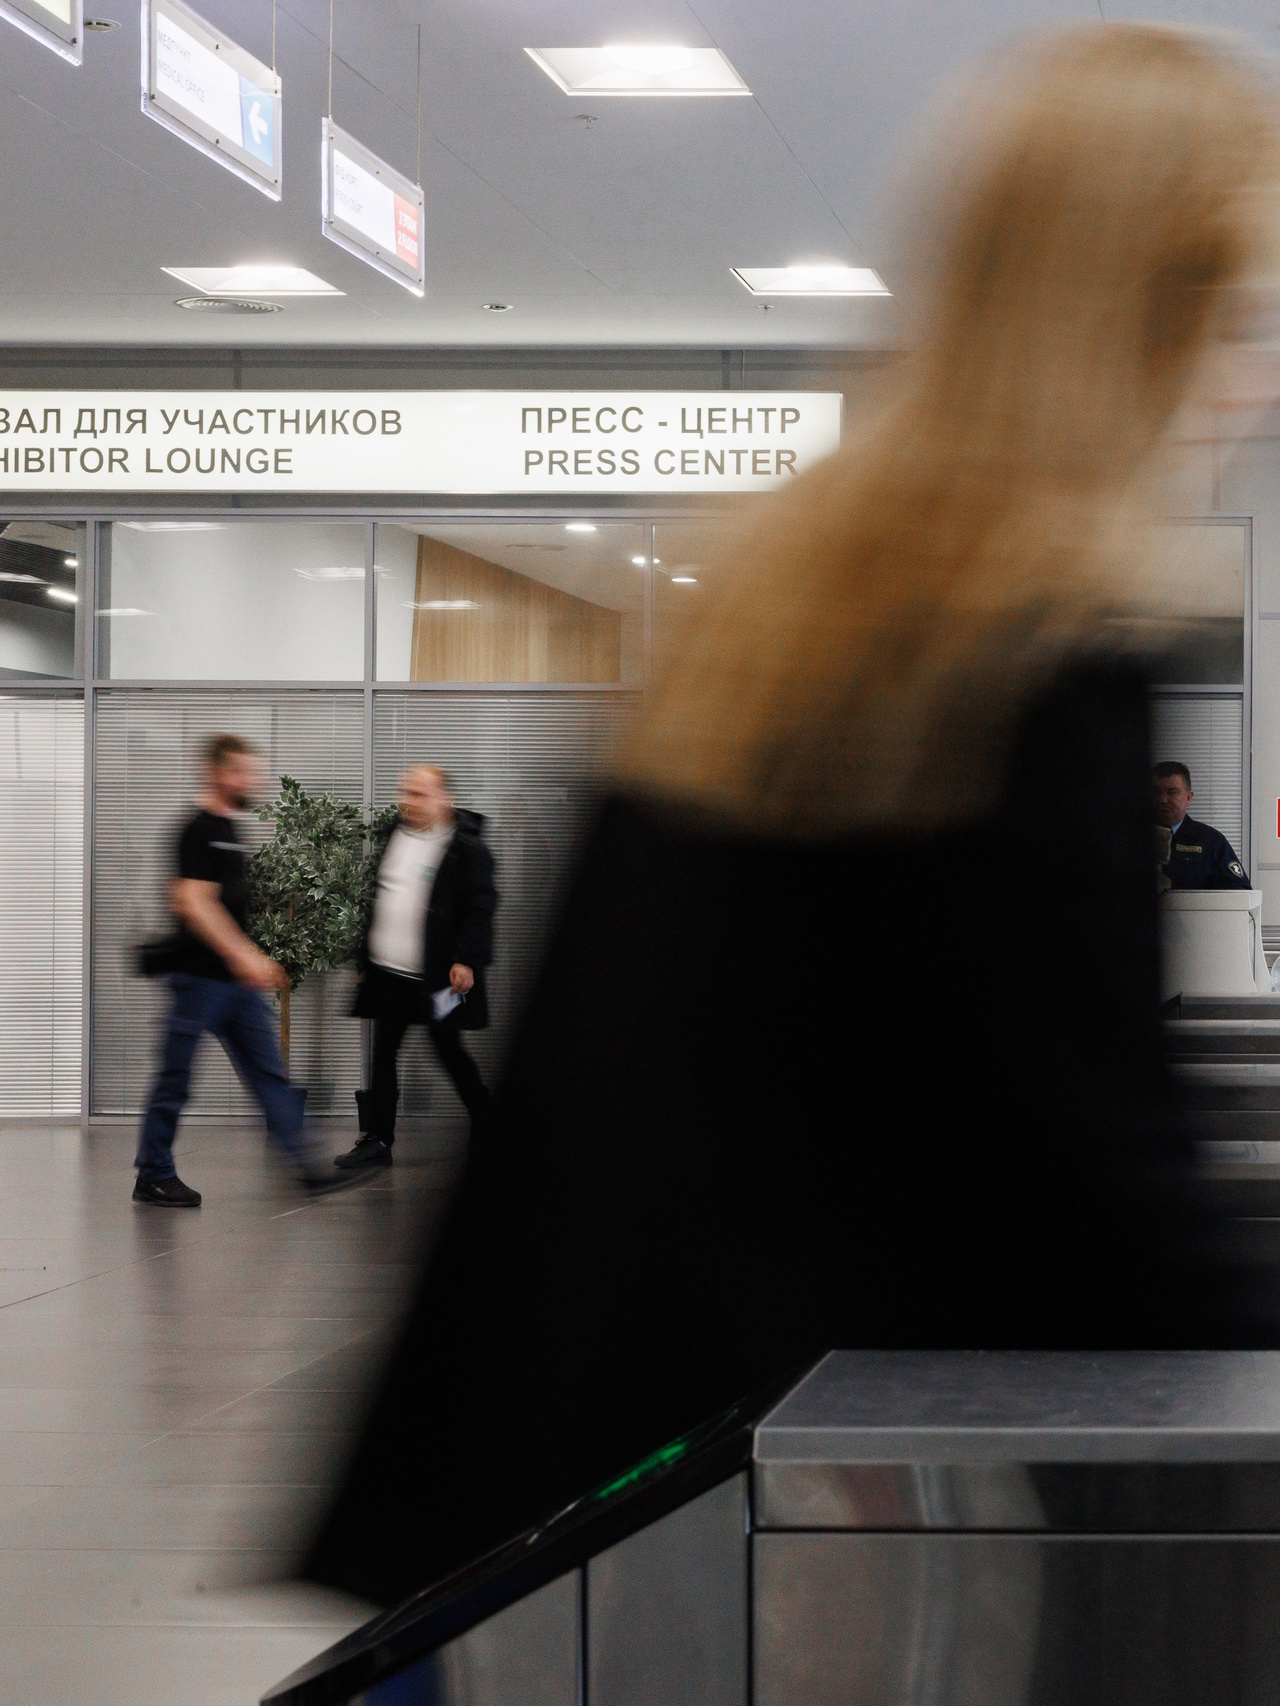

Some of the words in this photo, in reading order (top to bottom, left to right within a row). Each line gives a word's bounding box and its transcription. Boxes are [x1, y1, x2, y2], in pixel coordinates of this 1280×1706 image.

[157, 59, 184, 91] MEDICAL
[185, 78, 205, 103] OFFICE
[74, 408, 147, 439] ДЛЯ
[160, 408, 402, 436] УЧАСТНИКОВ
[521, 406, 644, 434] ПРЕСС
[681, 407, 801, 439] ЦЕНТР
[145, 447, 293, 474] LOUNGE
[524, 449, 640, 475] PRESS
[654, 449, 799, 476] CENTER
